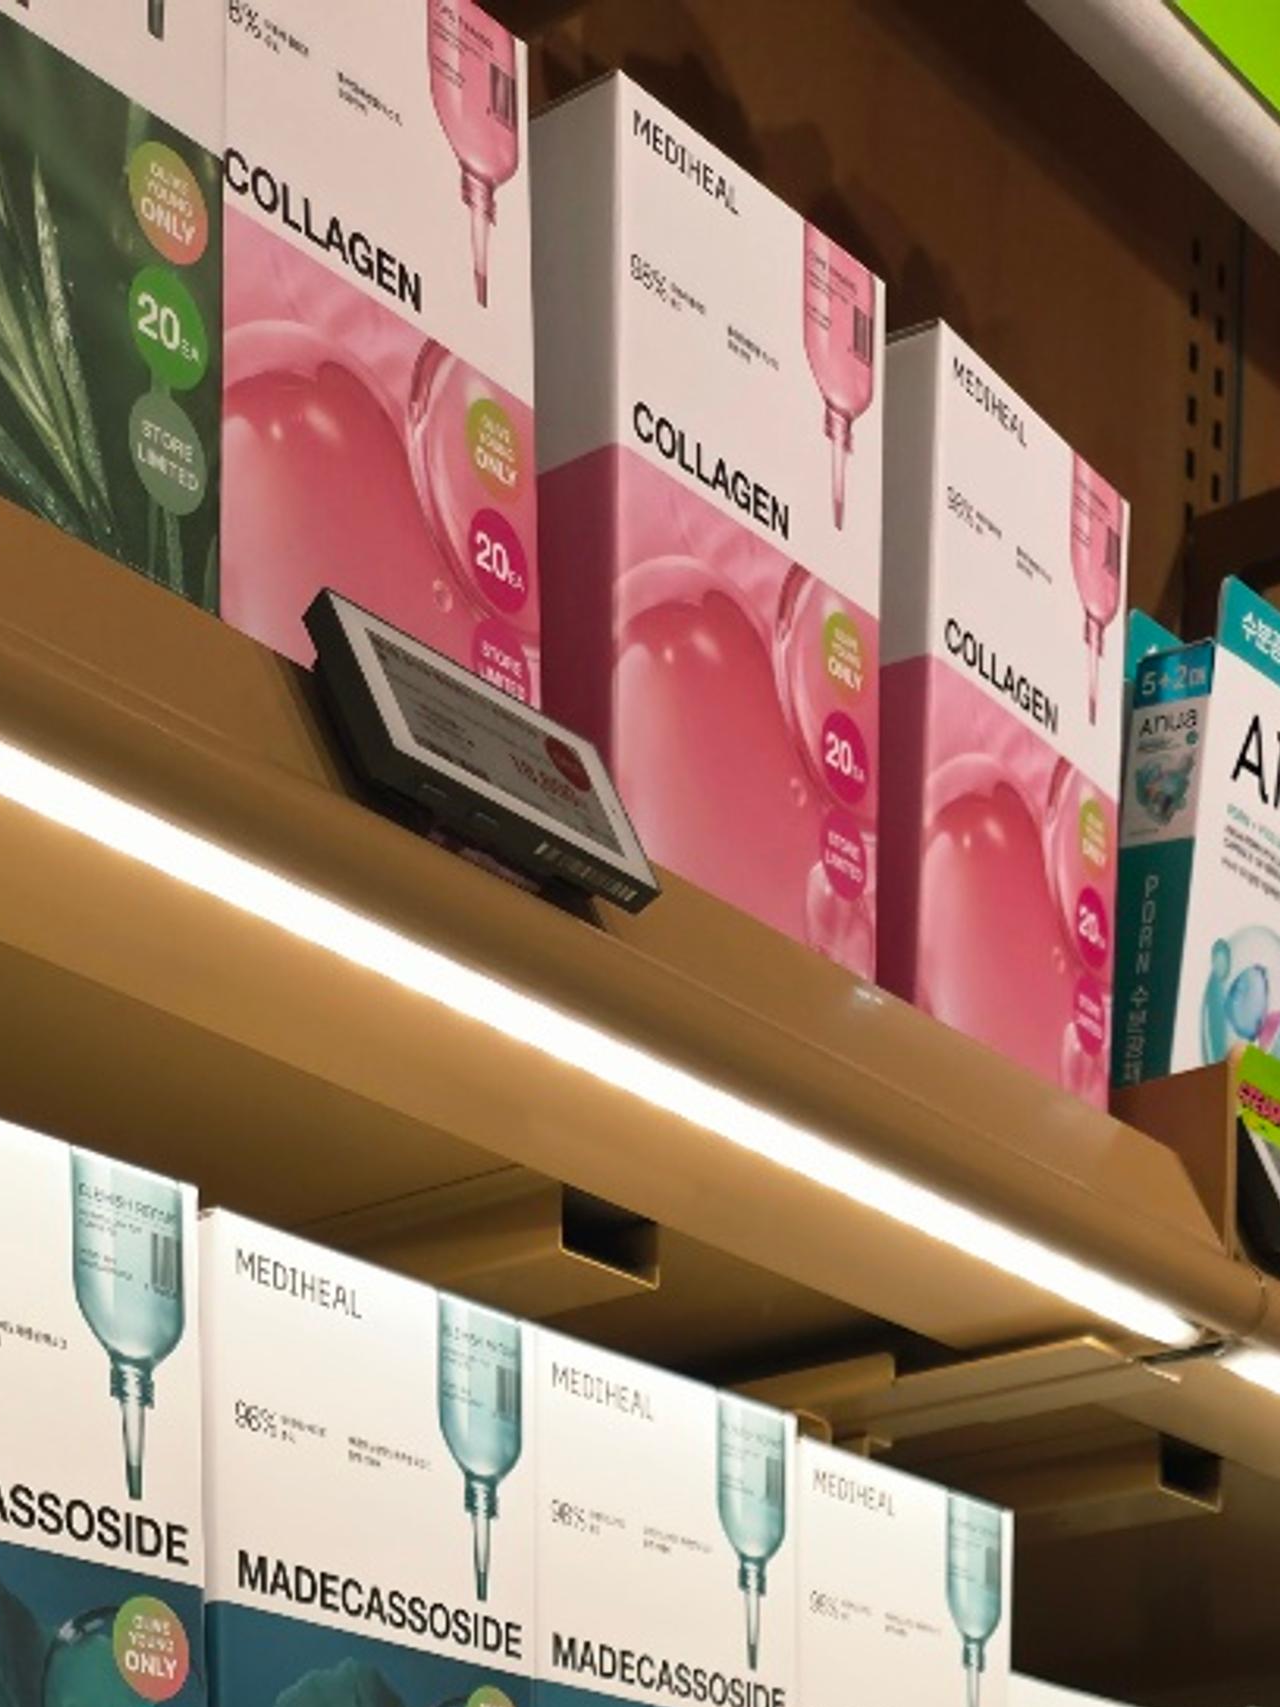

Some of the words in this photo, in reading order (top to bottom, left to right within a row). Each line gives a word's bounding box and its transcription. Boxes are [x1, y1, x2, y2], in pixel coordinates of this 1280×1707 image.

[632, 108, 740, 217] MEDIHEAL
[140, 193, 198, 247] ONLY
[222, 146, 424, 314] COLLAGEN
[951, 356, 1029, 449] MEDIHEAL
[631, 400, 791, 542] COLLAGEN
[942, 616, 1061, 735] COLLAGEN
[1137, 706, 1199, 738] Anua
[235, 1247, 363, 1320] MEDIHEAL
[551, 1361, 655, 1423] MEDIHEAL
[811, 1467, 897, 1519] MEDIHEAL
[237, 1549, 524, 1661] MADECASSOSIDE
[124, 1648, 179, 1682] ONLY
